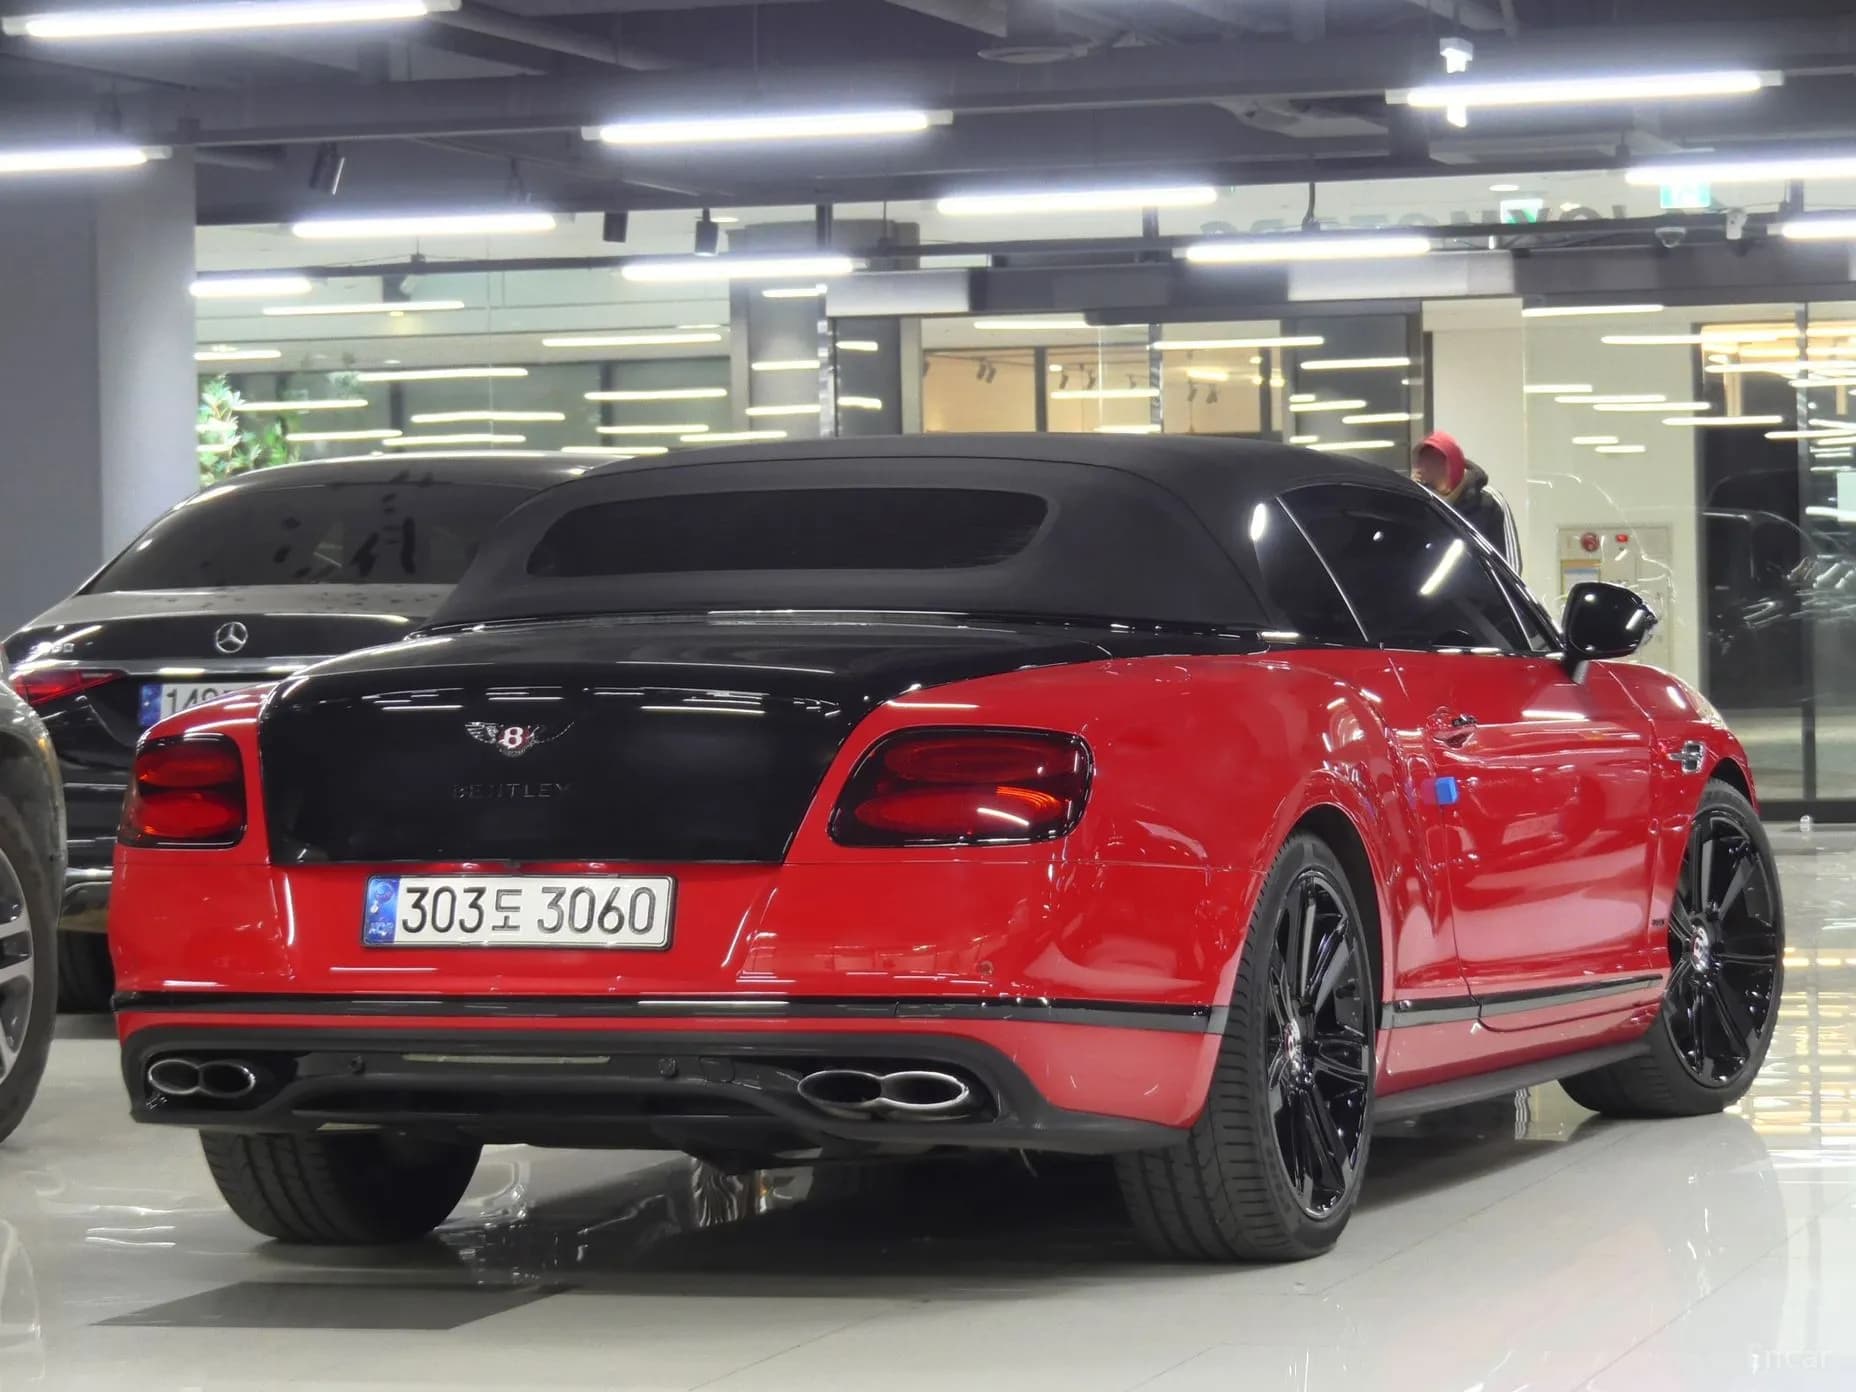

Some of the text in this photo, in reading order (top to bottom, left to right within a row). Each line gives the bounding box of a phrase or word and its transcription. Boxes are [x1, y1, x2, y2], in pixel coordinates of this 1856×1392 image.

[454, 783, 571, 799] BENTLEY
[402, 886, 656, 934] 303도 3060
